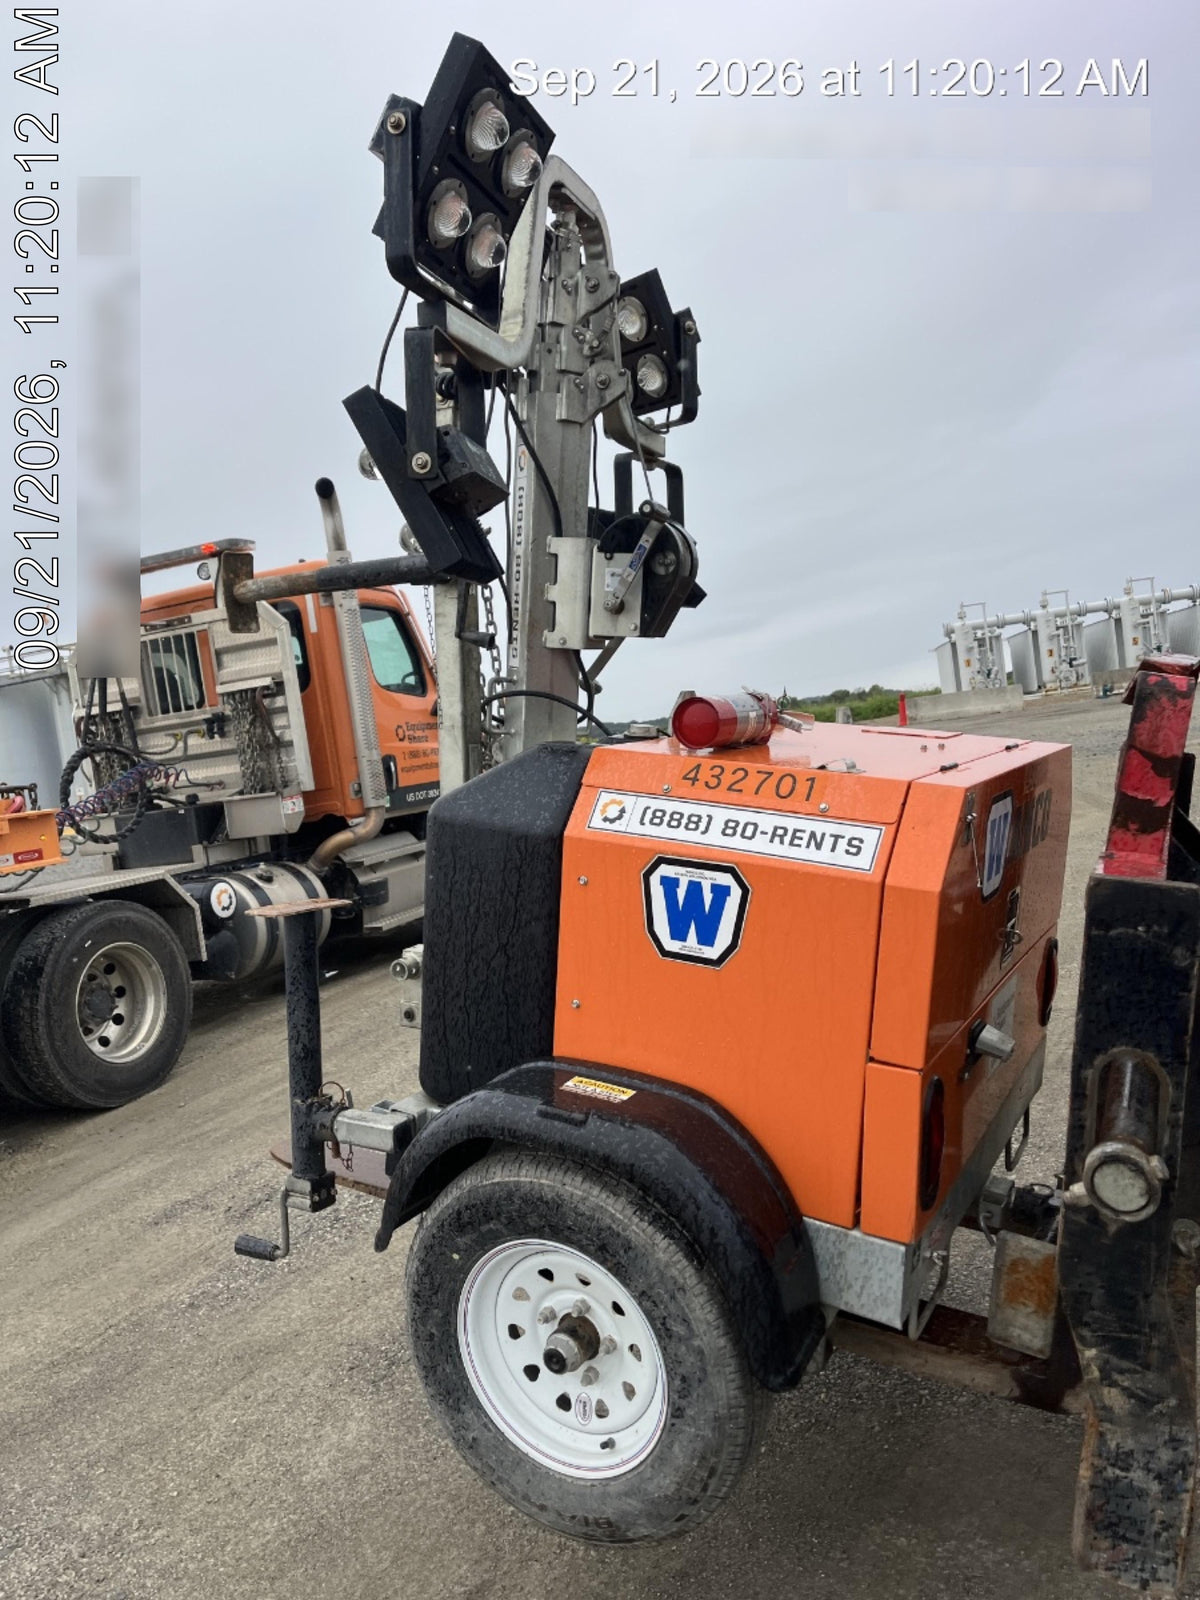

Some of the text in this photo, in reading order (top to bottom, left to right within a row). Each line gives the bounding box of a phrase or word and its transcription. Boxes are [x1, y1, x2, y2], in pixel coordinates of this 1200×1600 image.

[415, 791, 426, 801] DOT
[682, 763, 817, 802] 432701
[639, 806, 865, 857] (888) 80-RENTS
[660, 875, 731, 948] W
[583, 1081, 629, 1095] CAUTION
